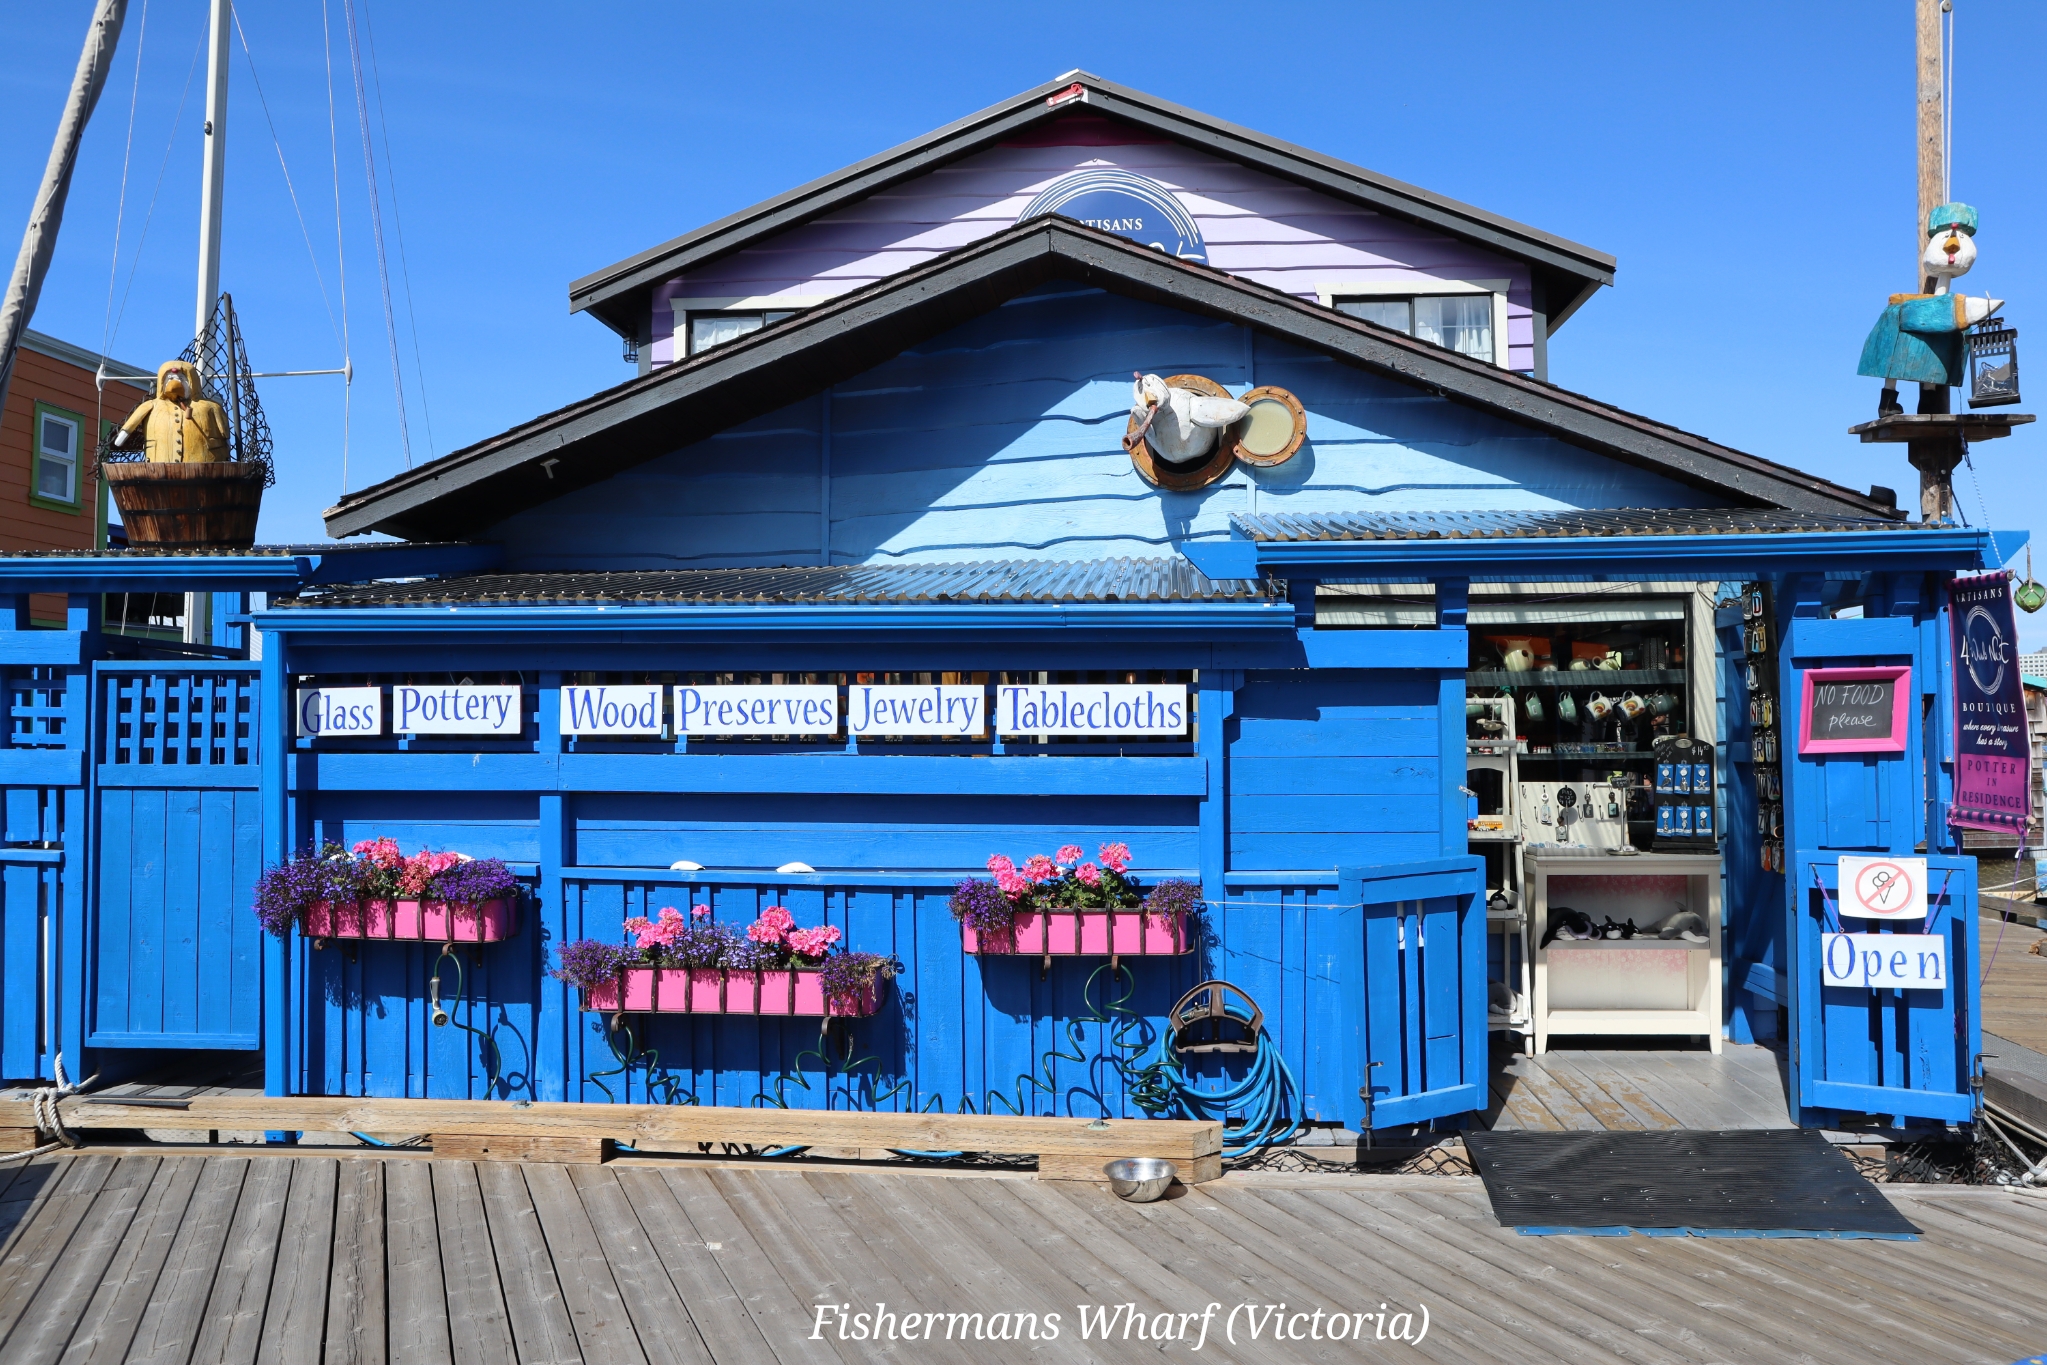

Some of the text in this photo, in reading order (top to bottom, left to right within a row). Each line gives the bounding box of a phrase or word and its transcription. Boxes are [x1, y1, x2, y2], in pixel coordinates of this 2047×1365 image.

[301, 691, 373, 733] Glass
[401, 687, 512, 730] Pottery
[568, 687, 657, 730] Wood
[680, 688, 833, 731] Preserves
[853, 687, 978, 732] Jewelry
[1002, 687, 1182, 731] Tablecloths
[1813, 683, 1884, 708] NO FOOD
[1962, 702, 2016, 715] BOUTIQUE
[1828, 713, 1877, 732] please
[1976, 733, 1987, 745] has
[1967, 760, 2016, 774] POTTER
[1986, 777, 1997, 787] IN
[1962, 790, 2021, 809] RESIDENCE
[1827, 934, 1941, 988] Open
